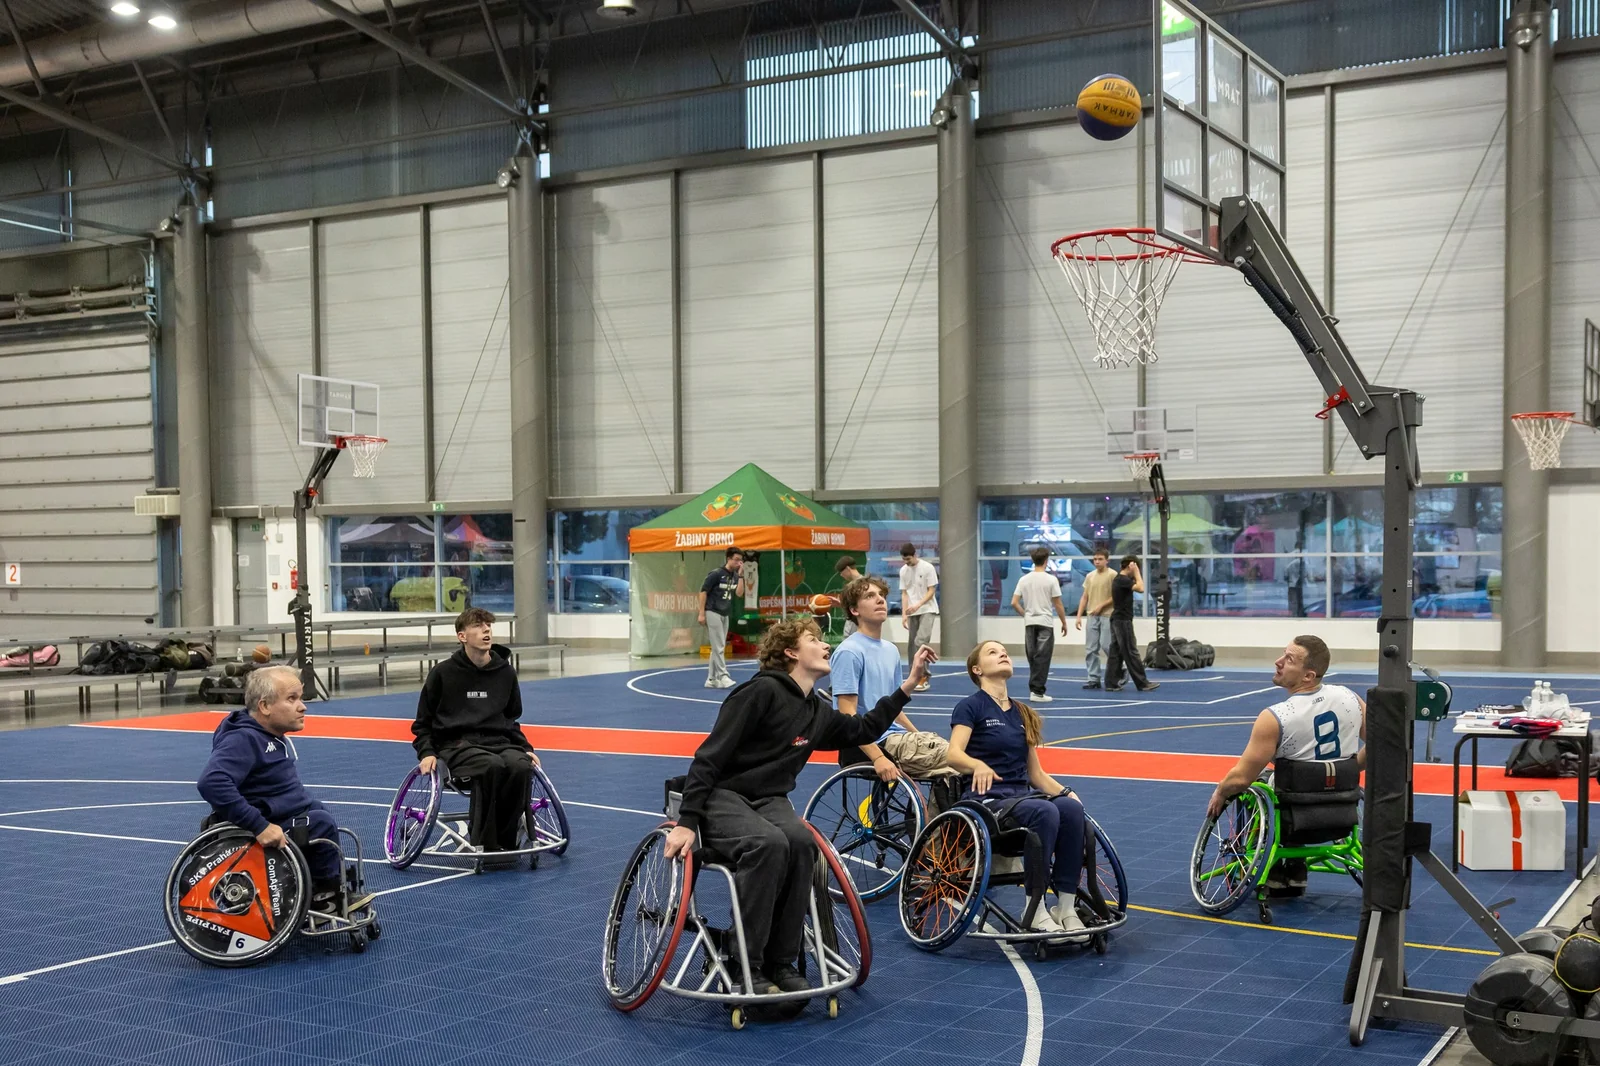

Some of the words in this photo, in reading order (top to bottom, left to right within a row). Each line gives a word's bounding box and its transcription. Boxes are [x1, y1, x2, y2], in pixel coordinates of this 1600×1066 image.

[1094, 102, 1135, 120] TARMAK
[675, 530, 707, 546] ŽABINY
[708, 532, 734, 546] BRNO
[811, 528, 830, 545] ŽABINY
[830, 532, 846, 546] BRNO
[10, 564, 16, 582] 2
[1156, 594, 1166, 640] TARMAK
[304, 610, 312, 664] TARMAK
[1314, 710, 1340, 760] 8
[188, 870, 202, 886] SK
